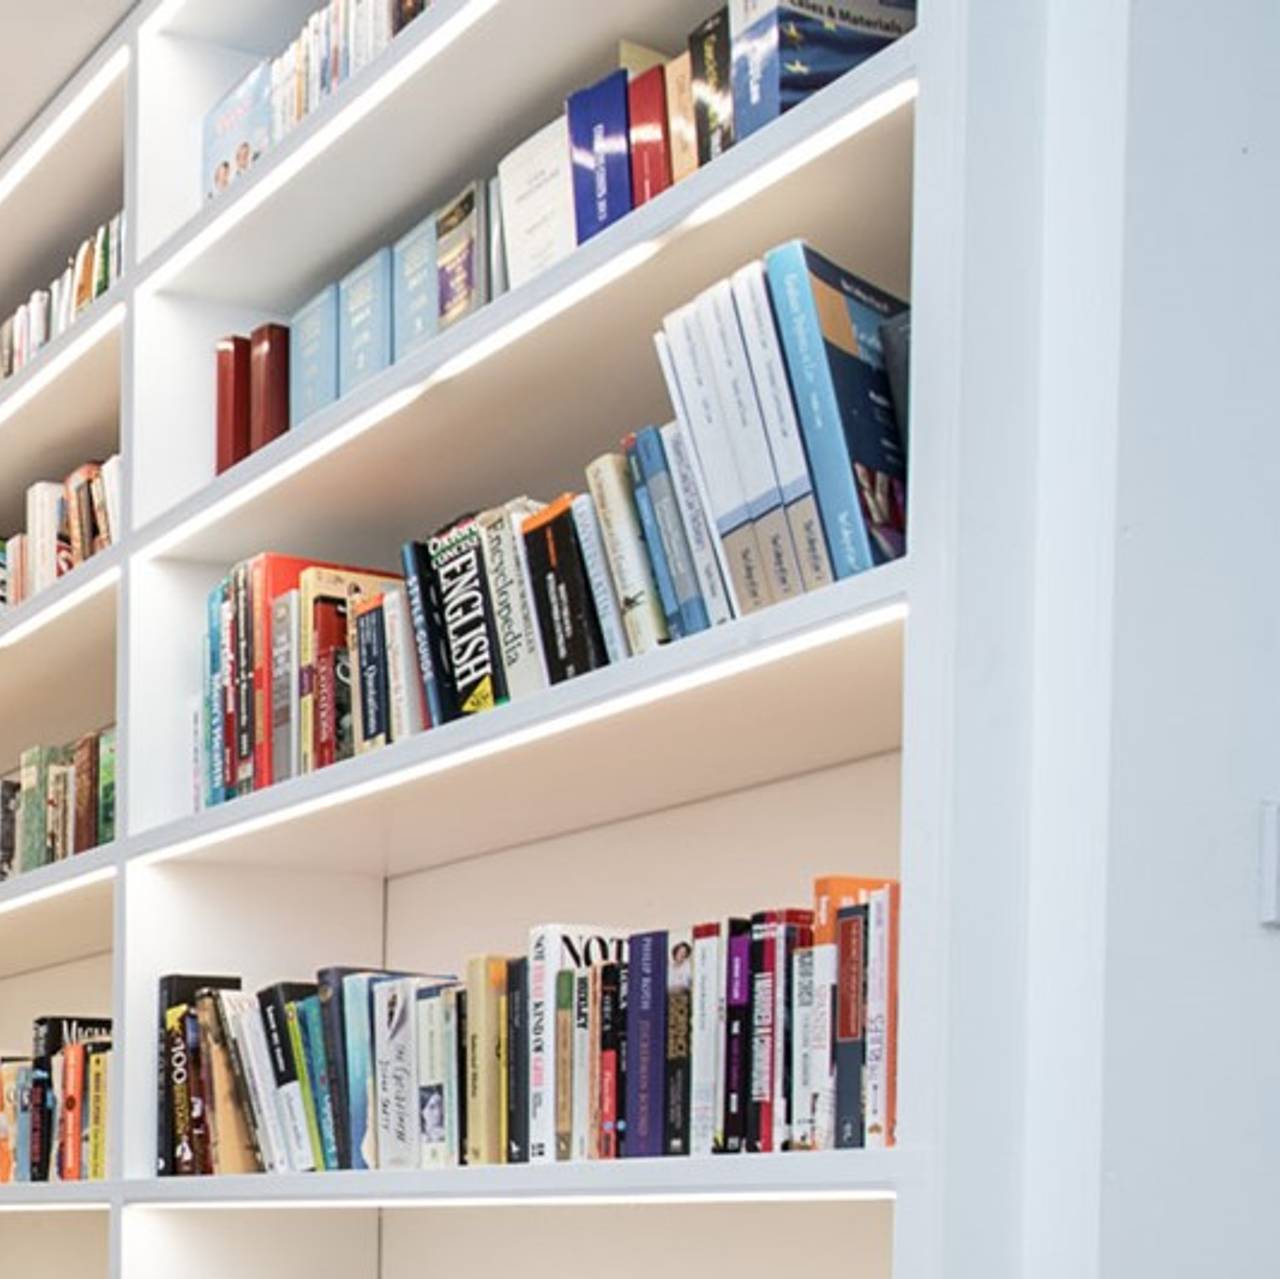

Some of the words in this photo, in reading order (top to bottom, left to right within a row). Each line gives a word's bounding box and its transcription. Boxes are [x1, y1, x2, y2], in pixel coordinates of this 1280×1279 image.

[441, 551, 491, 692] ENGLISH
[488, 517, 522, 666] Encyclopedia
[406, 575, 423, 624] STYLE
[416, 628, 434, 682] GUIDE
[365, 664, 379, 735] Quotations
[561, 934, 629, 968] NOT
[641, 937, 652, 973] PHILIP
[533, 1001, 546, 1035] KIND
[640, 976, 652, 1010] ROTH
[751, 1035, 773, 1102] COMMUNIST
